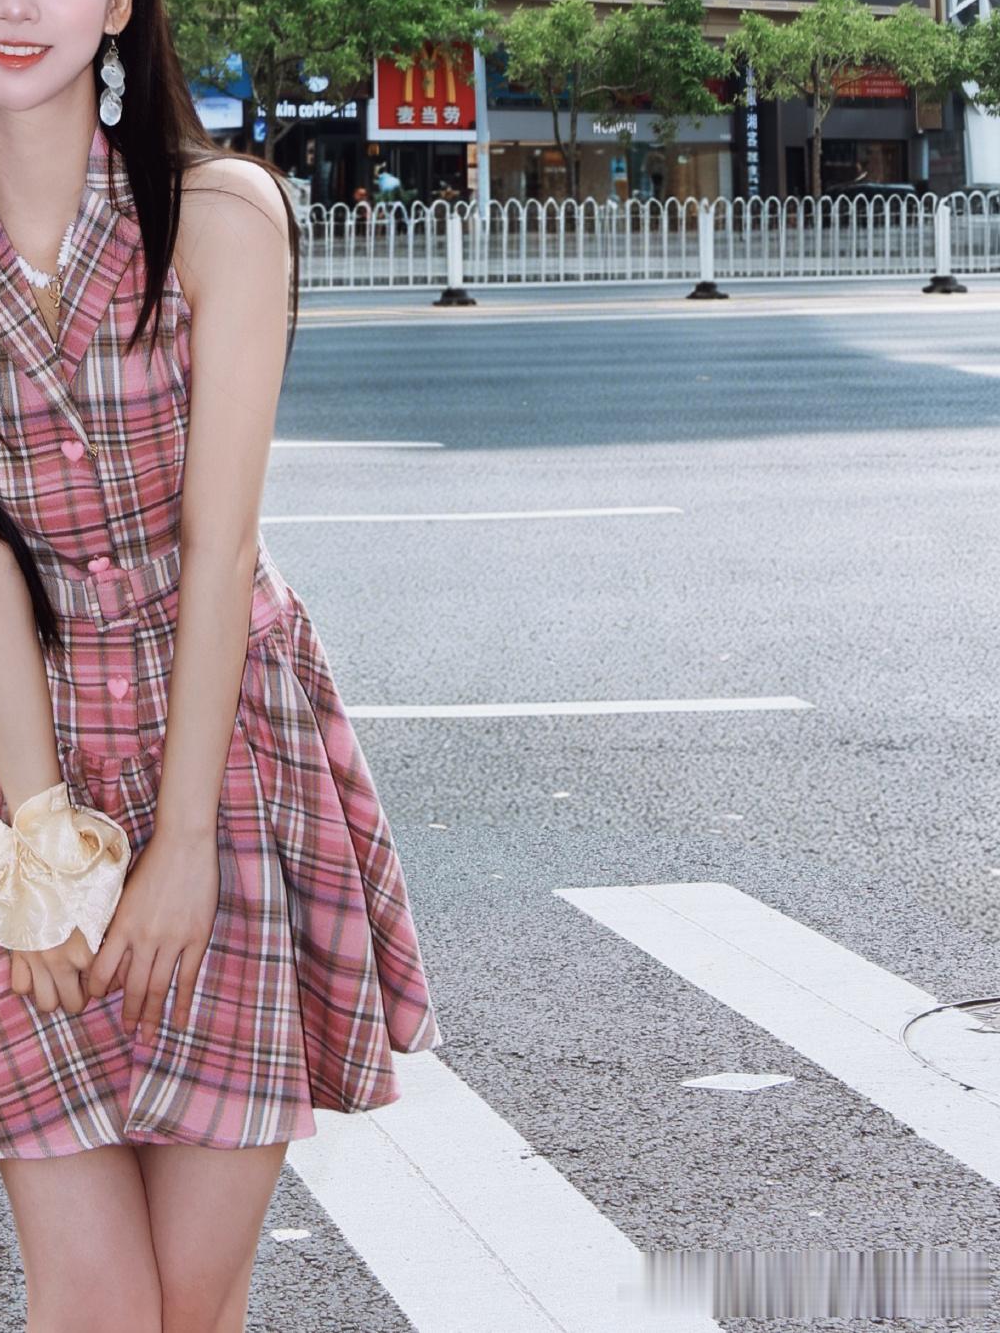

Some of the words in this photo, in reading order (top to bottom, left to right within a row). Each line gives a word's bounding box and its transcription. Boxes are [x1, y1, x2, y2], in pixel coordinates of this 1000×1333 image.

[397, 105, 461, 125] 麦当劳
[593, 121, 637, 134] HUAWEI
